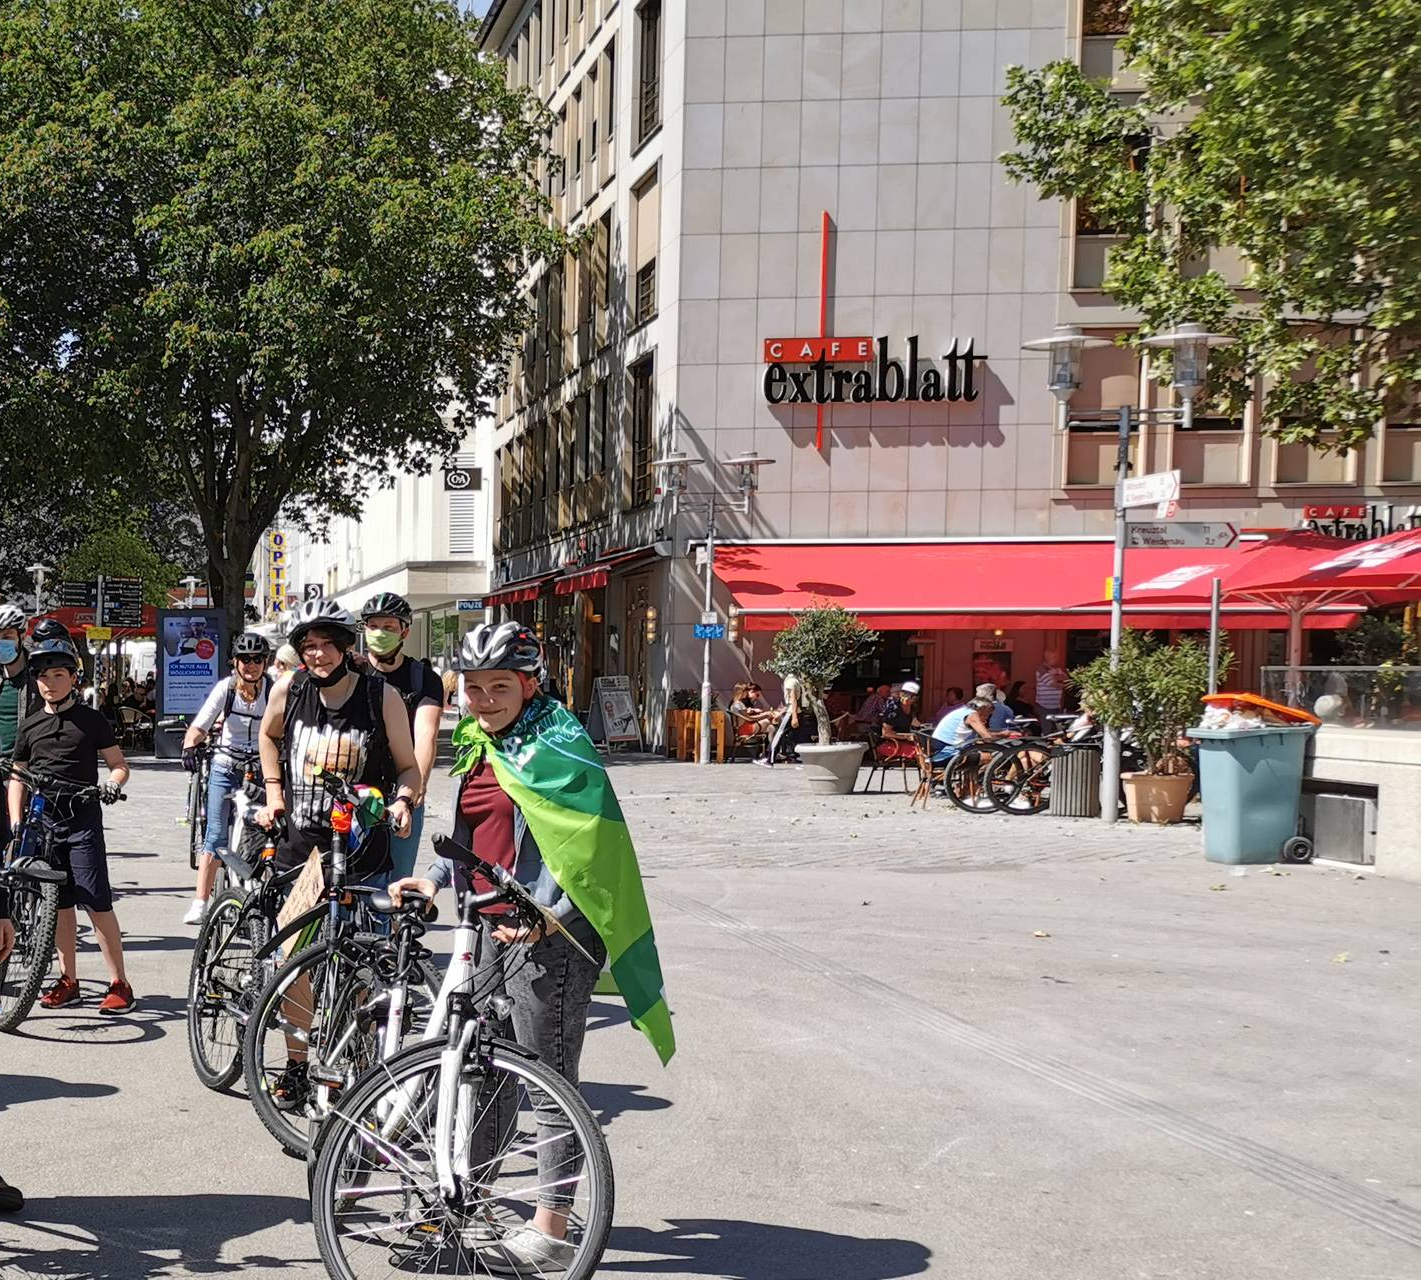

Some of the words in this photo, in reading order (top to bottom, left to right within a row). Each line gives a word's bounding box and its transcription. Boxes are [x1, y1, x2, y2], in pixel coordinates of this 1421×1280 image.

[769, 342, 868, 358] CAFE
[762, 335, 989, 404] extrablatt
[1308, 507, 1366, 517] CAFE
[1130, 525, 1168, 535] Kreuztal
[1142, 536, 1186, 546] Weidenau
[273, 533, 284, 612] OPTIK
[458, 601, 483, 609] POLIZE
